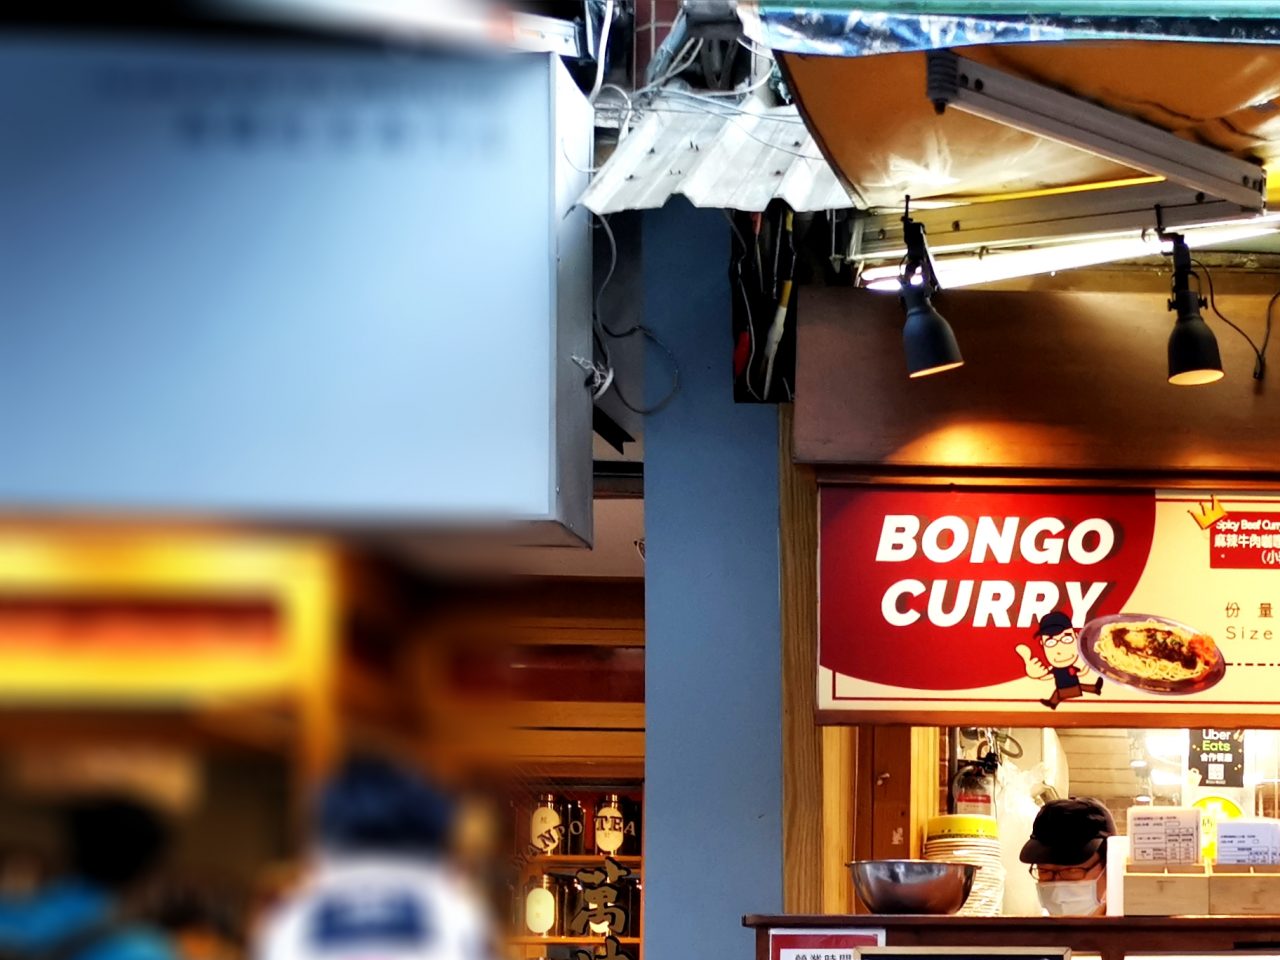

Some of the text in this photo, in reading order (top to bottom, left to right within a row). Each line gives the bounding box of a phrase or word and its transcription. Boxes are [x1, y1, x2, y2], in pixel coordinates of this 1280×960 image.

[875, 514, 1115, 565] BONGO
[881, 578, 1108, 629] CURRY
[1225, 626, 1274, 640] Size
[1202, 729, 1231, 740] Uber
[1202, 740, 1231, 752] Eats
[594, 816, 636, 836] TEA
